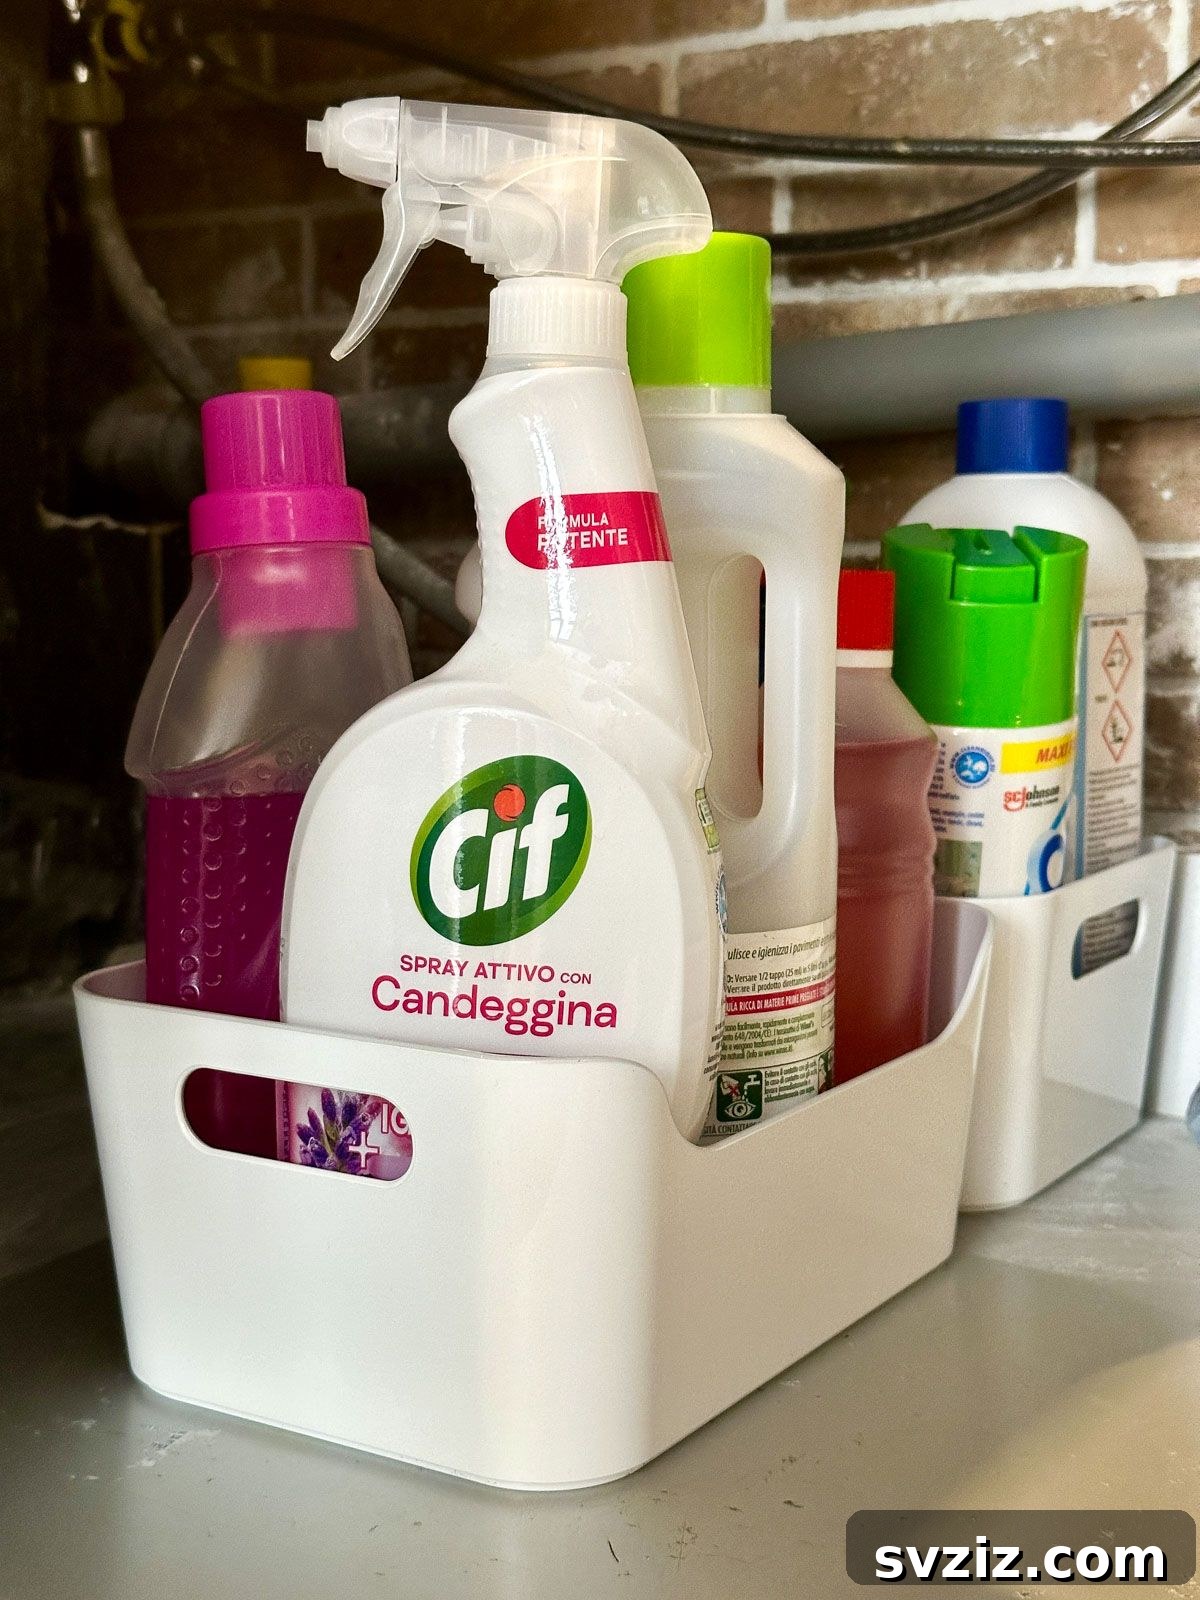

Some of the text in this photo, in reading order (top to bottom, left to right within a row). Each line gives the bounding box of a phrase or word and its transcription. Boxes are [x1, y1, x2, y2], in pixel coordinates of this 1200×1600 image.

[537, 512, 609, 530] FRMULA
[537, 528, 629, 551] PTENTE
[428, 783, 570, 919] Cif
[727, 948, 751, 960] ulisce
[751, 949, 757, 959] e
[757, 944, 789, 961] igienizza
[400, 954, 592, 985] SPRAY ATTIVO CON
[734, 973, 758, 983] Versare
[759, 971, 769, 981] 1/2
[769, 970, 785, 981] tappo
[752, 983, 756, 992] il
[757, 981, 781, 993] prodotto
[371, 974, 618, 1037] Candeggina
[739, 1000, 756, 1011] RICCA
[756, 999, 763, 1010] DI
[763, 997, 785, 1009] MATERIE
